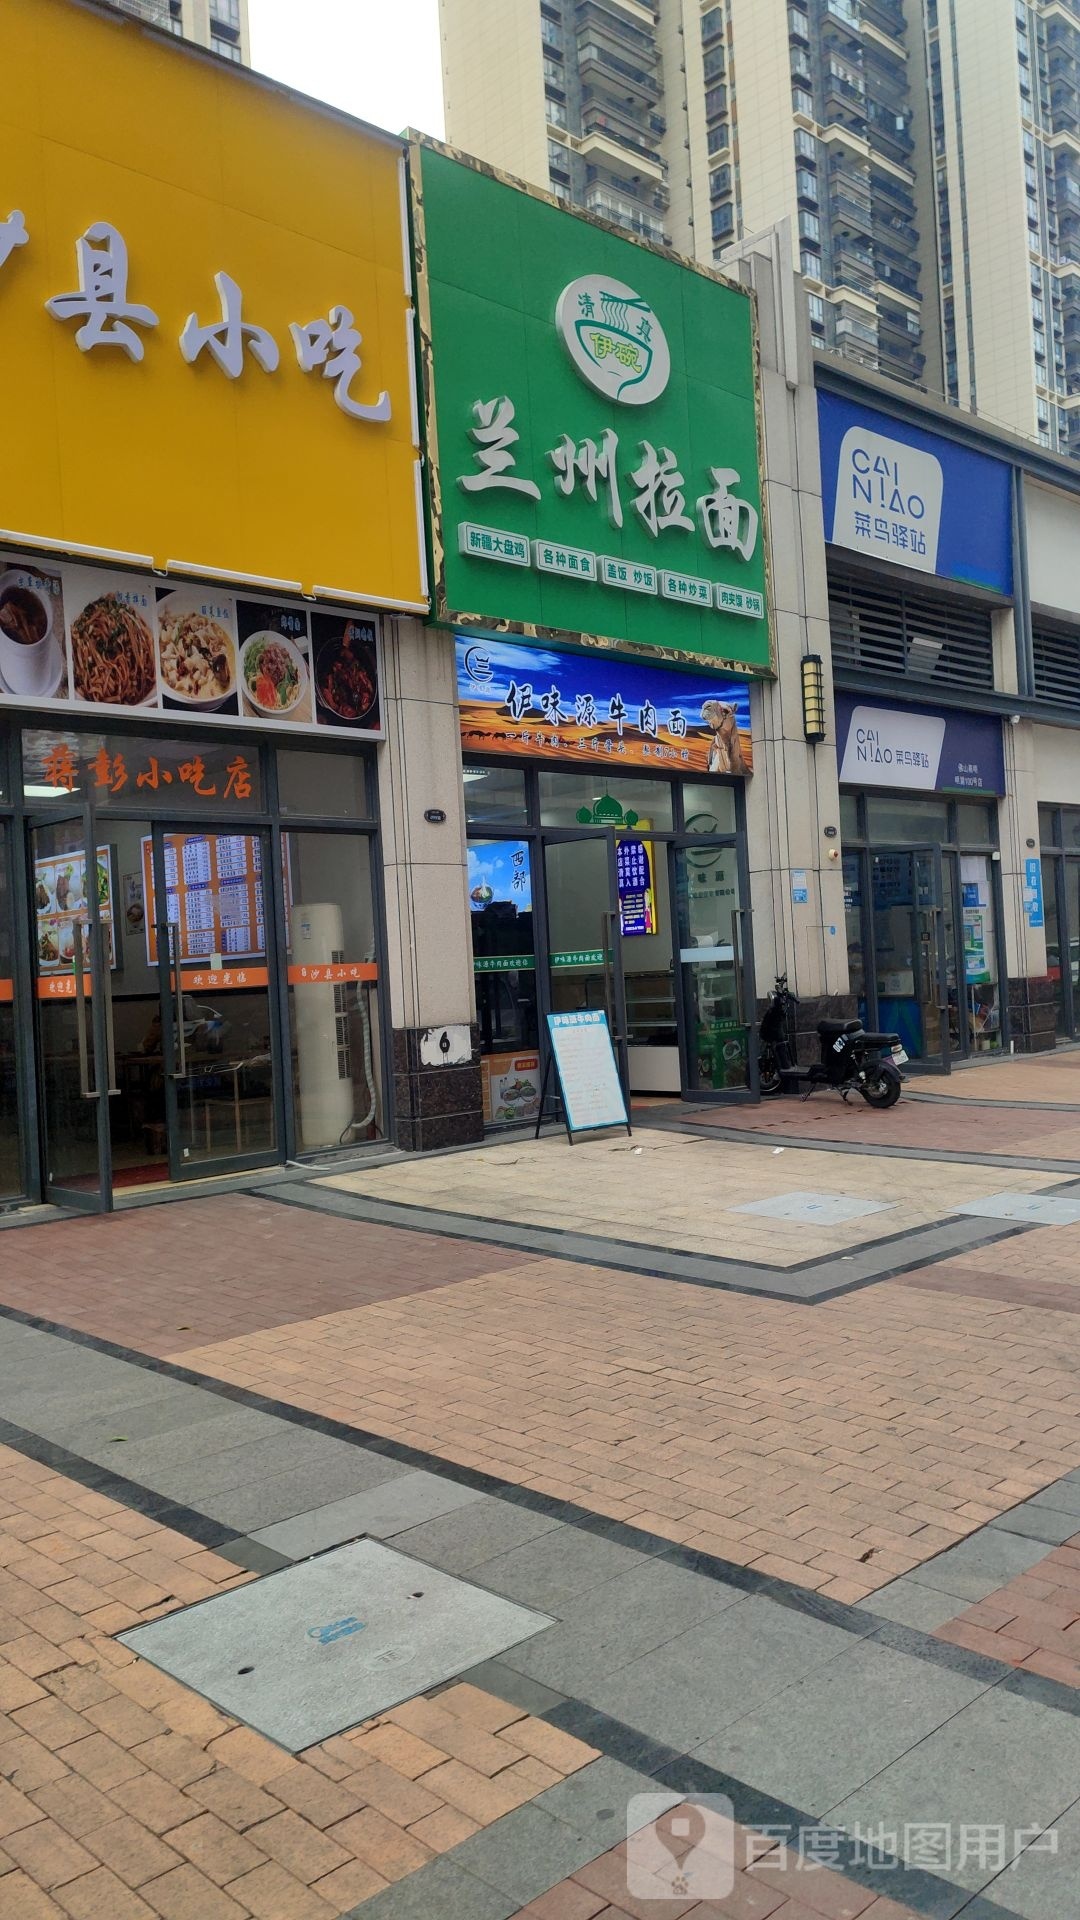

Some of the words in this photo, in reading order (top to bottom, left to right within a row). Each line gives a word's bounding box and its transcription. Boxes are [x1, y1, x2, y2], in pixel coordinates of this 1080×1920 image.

[0, 209, 392, 423] 县小吃
[456, 395, 759, 562] 兰州拉面
[852, 448, 899, 486] CAI
[470, 531, 525, 559] 新疆大盘鸡
[854, 510, 927, 556] 菜鸟驿站
[543, 548, 591, 573] 各种面食
[607, 563, 628, 582] 盖饭
[633, 569, 653, 587] 炒饭
[667, 578, 709, 601] 各种炒菜
[505, 680, 688, 739] 伊味源牛肉面
[856, 728, 880, 746] CAI
[895, 749, 930, 768] 菜鸟驿站
[193, 971, 247, 986] 欢迎光临
[311, 967, 361, 980] 沙县小吃
